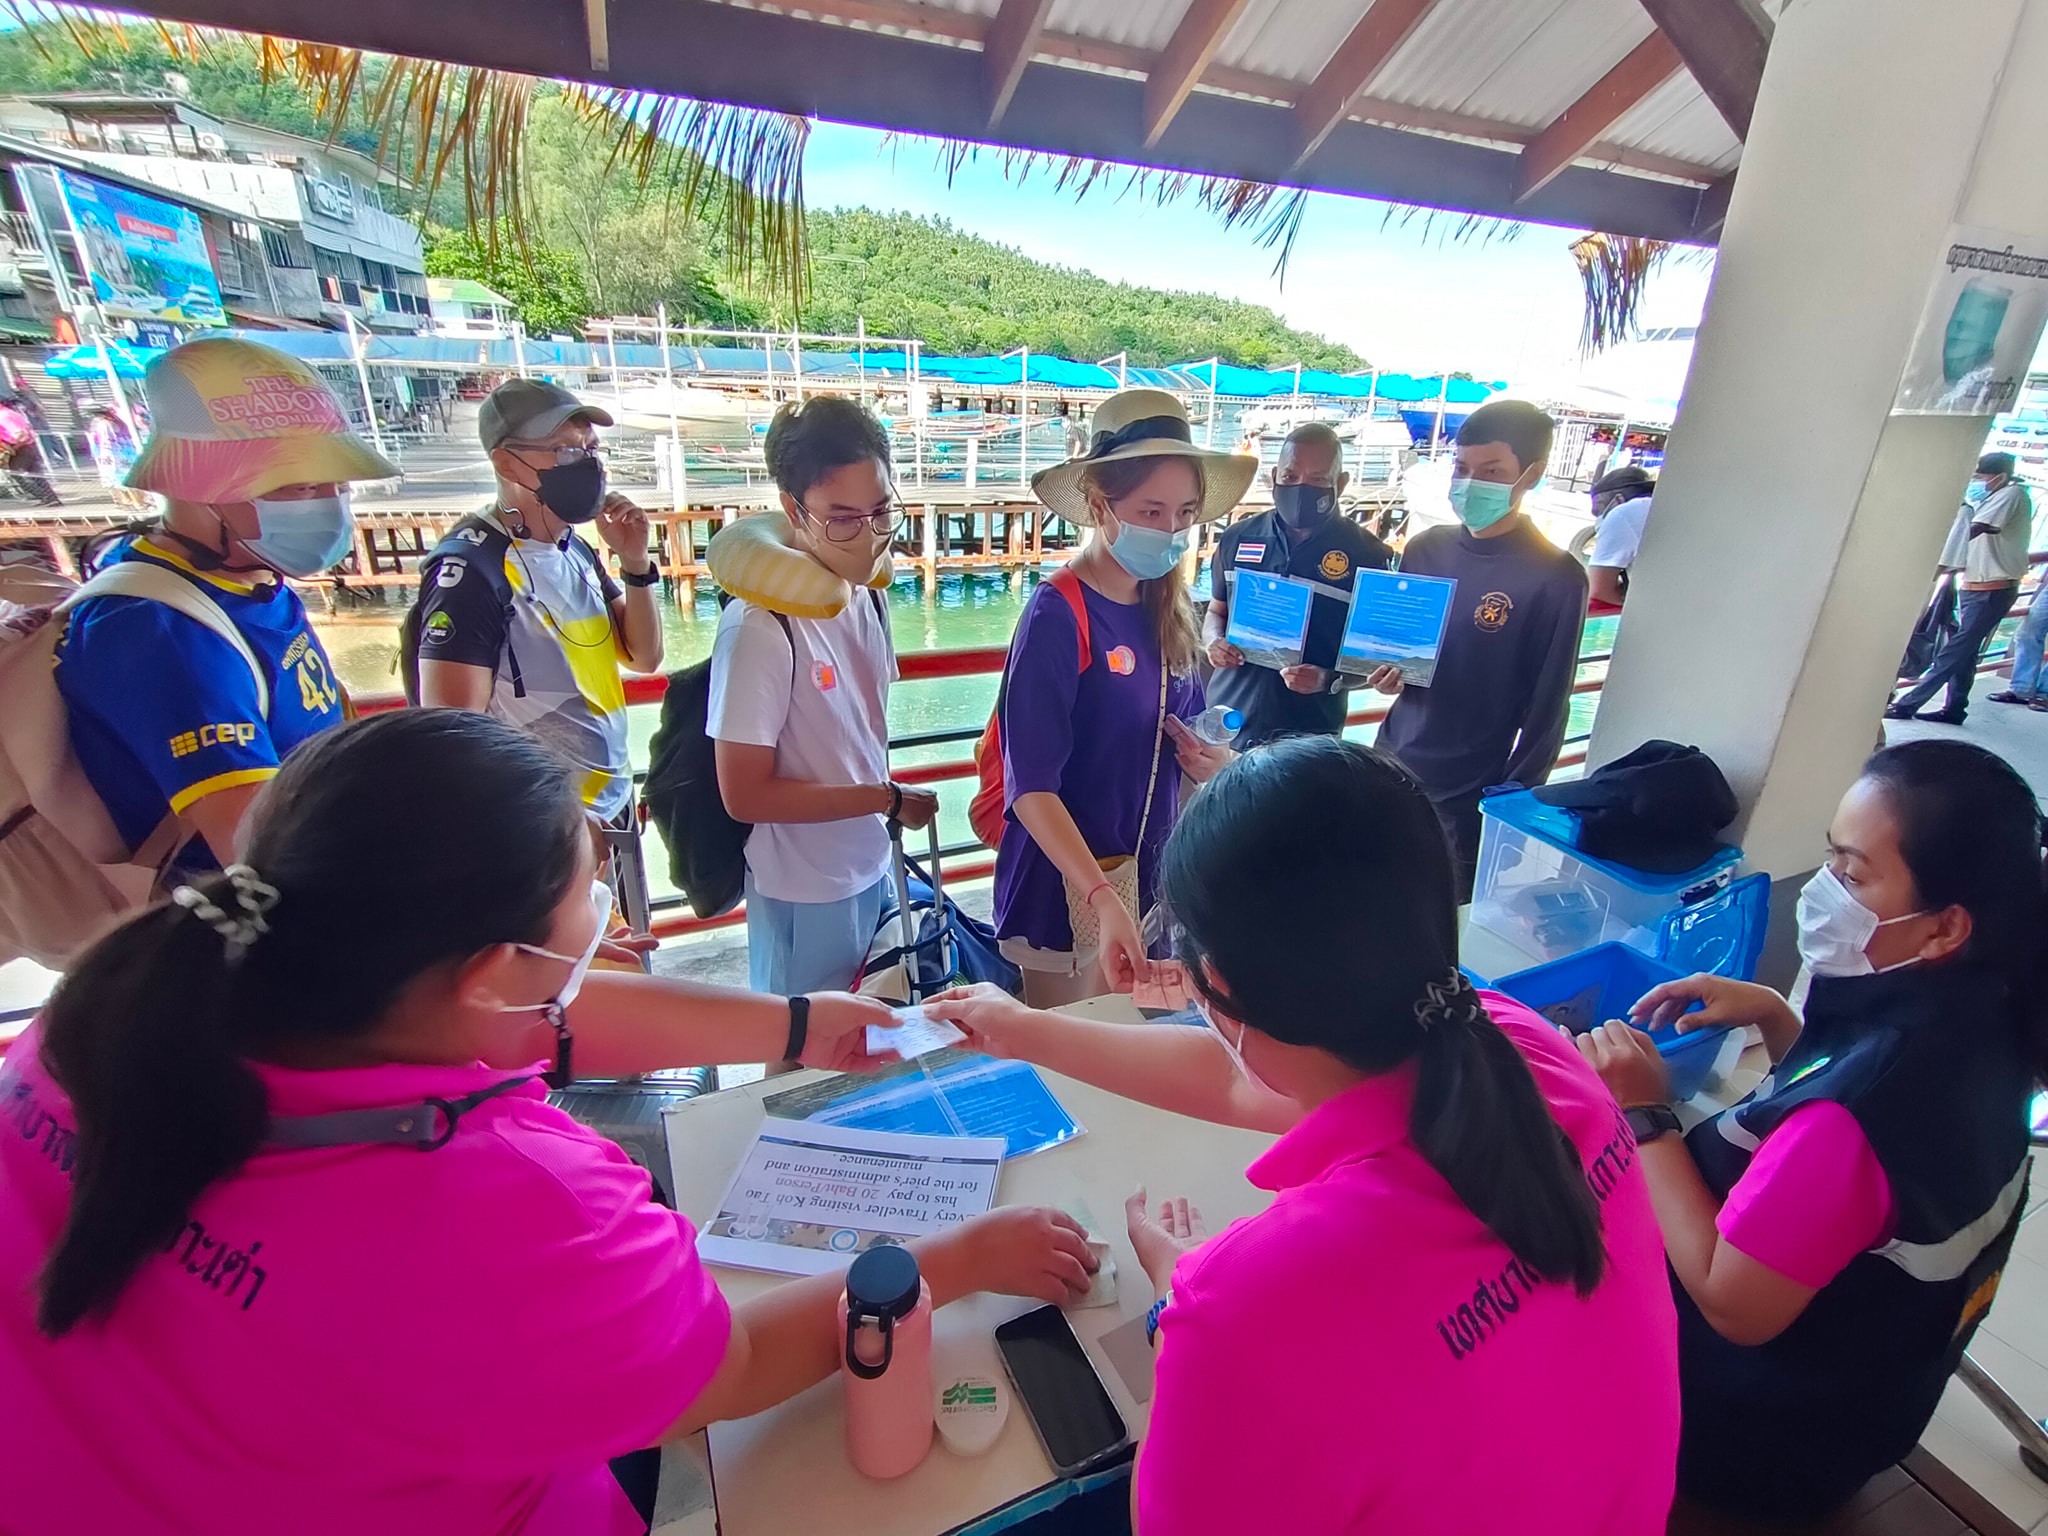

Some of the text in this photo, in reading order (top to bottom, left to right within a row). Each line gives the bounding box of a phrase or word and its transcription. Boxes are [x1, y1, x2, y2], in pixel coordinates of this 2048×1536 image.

[244, 376, 295, 392] THE
[297, 647, 337, 715] 42
[839, 1154, 923, 1172] maintenance
[764, 1159, 979, 1193] for the pier's administration and
[745, 1189, 771, 1204] Tao
[775, 1177, 958, 1208] has to pay 20 Baht/Person
[775, 1194, 806, 1208] Koh
[809, 1195, 861, 1214] visiting
[864, 1203, 929, 1222] Traveller
